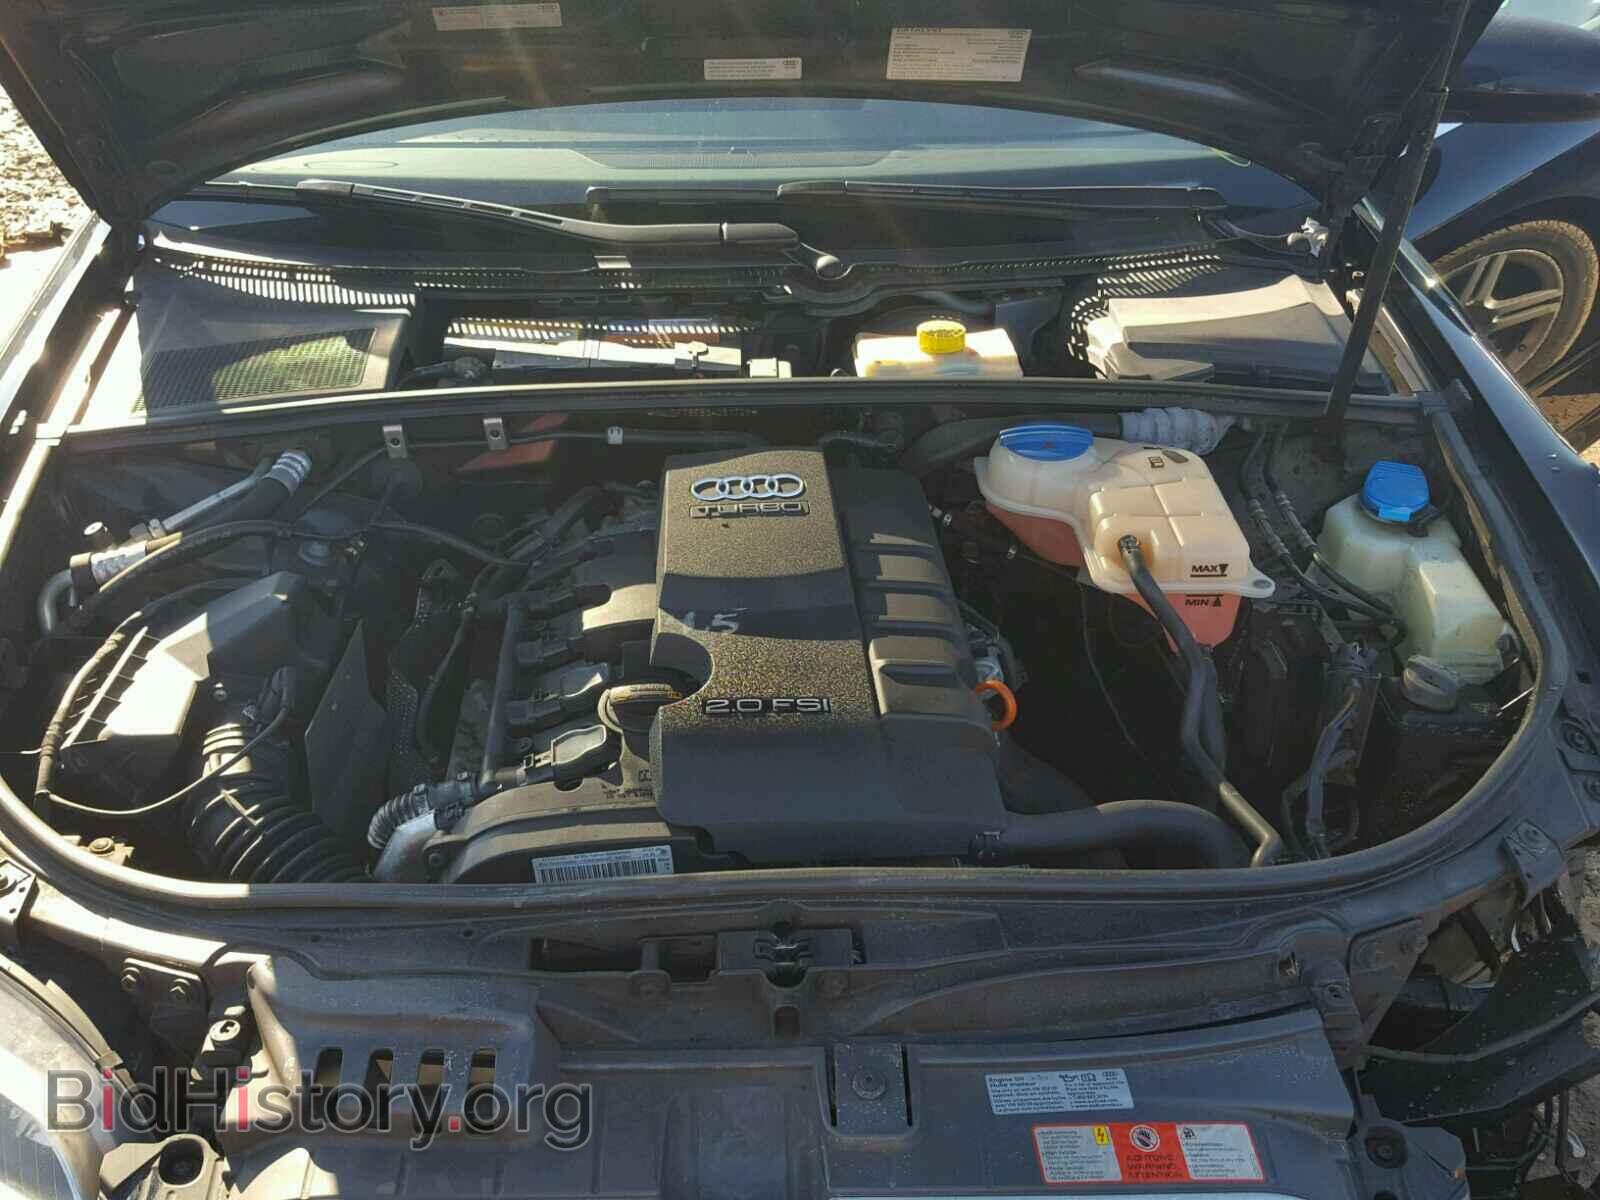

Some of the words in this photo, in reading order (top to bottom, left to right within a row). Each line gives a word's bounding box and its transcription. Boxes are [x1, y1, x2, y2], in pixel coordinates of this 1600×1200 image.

[1192, 564, 1218, 573] MAX
[705, 698, 762, 713] 2.0
[772, 698, 831, 713] FSI
